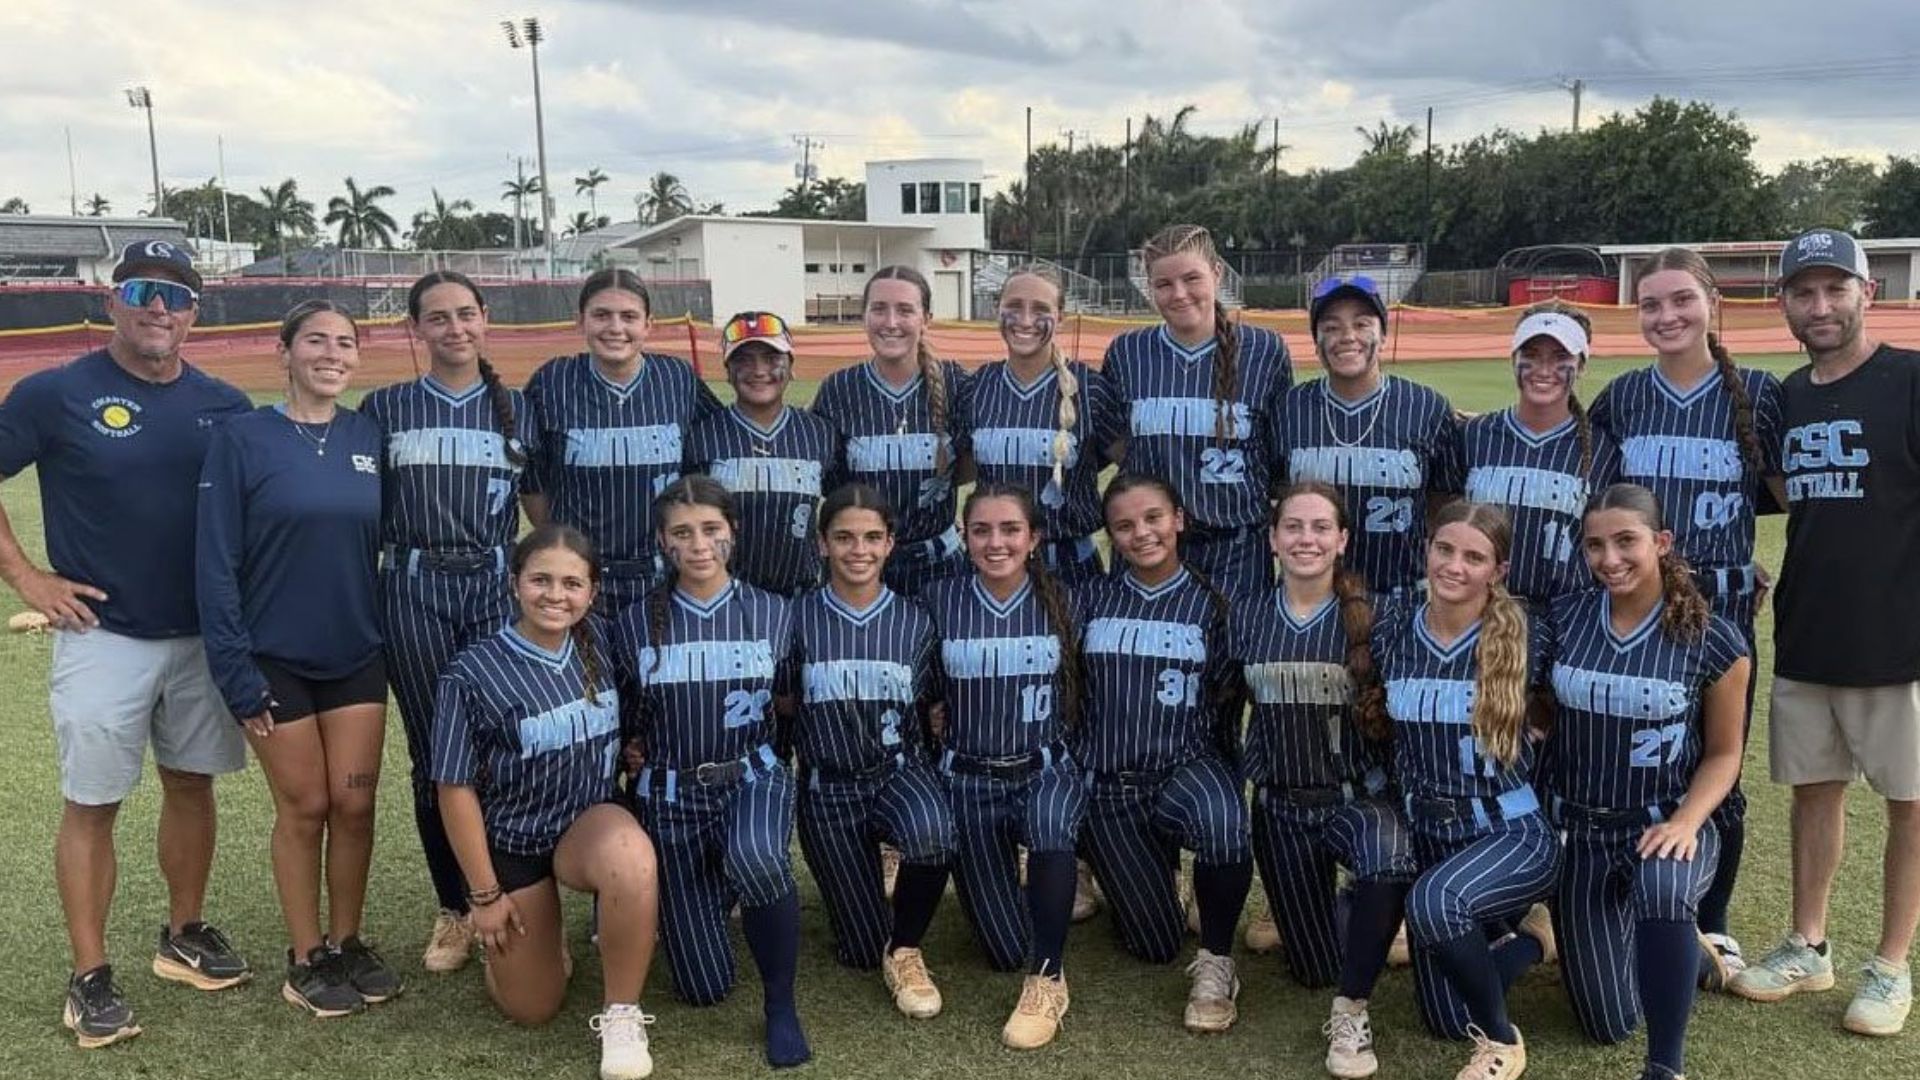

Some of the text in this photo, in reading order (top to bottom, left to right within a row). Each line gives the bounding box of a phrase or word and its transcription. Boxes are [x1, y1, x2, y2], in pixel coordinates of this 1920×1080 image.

[91, 396, 142, 413] CHARTER
[1200, 447, 1245, 483] 22
[1619, 435, 1743, 482] PANTHERS
[1782, 420, 1870, 473] CSC
[1290, 446, 1422, 489] PANTHERS
[488, 477, 511, 516] 7
[1365, 496, 1413, 532] 23
[941, 635, 1061, 680] PANTHERS
[1022, 684, 1052, 723] 10
[1157, 668, 1199, 707] 31
[1384, 678, 1477, 724] PANTHE
[1629, 722, 1686, 767] 27
